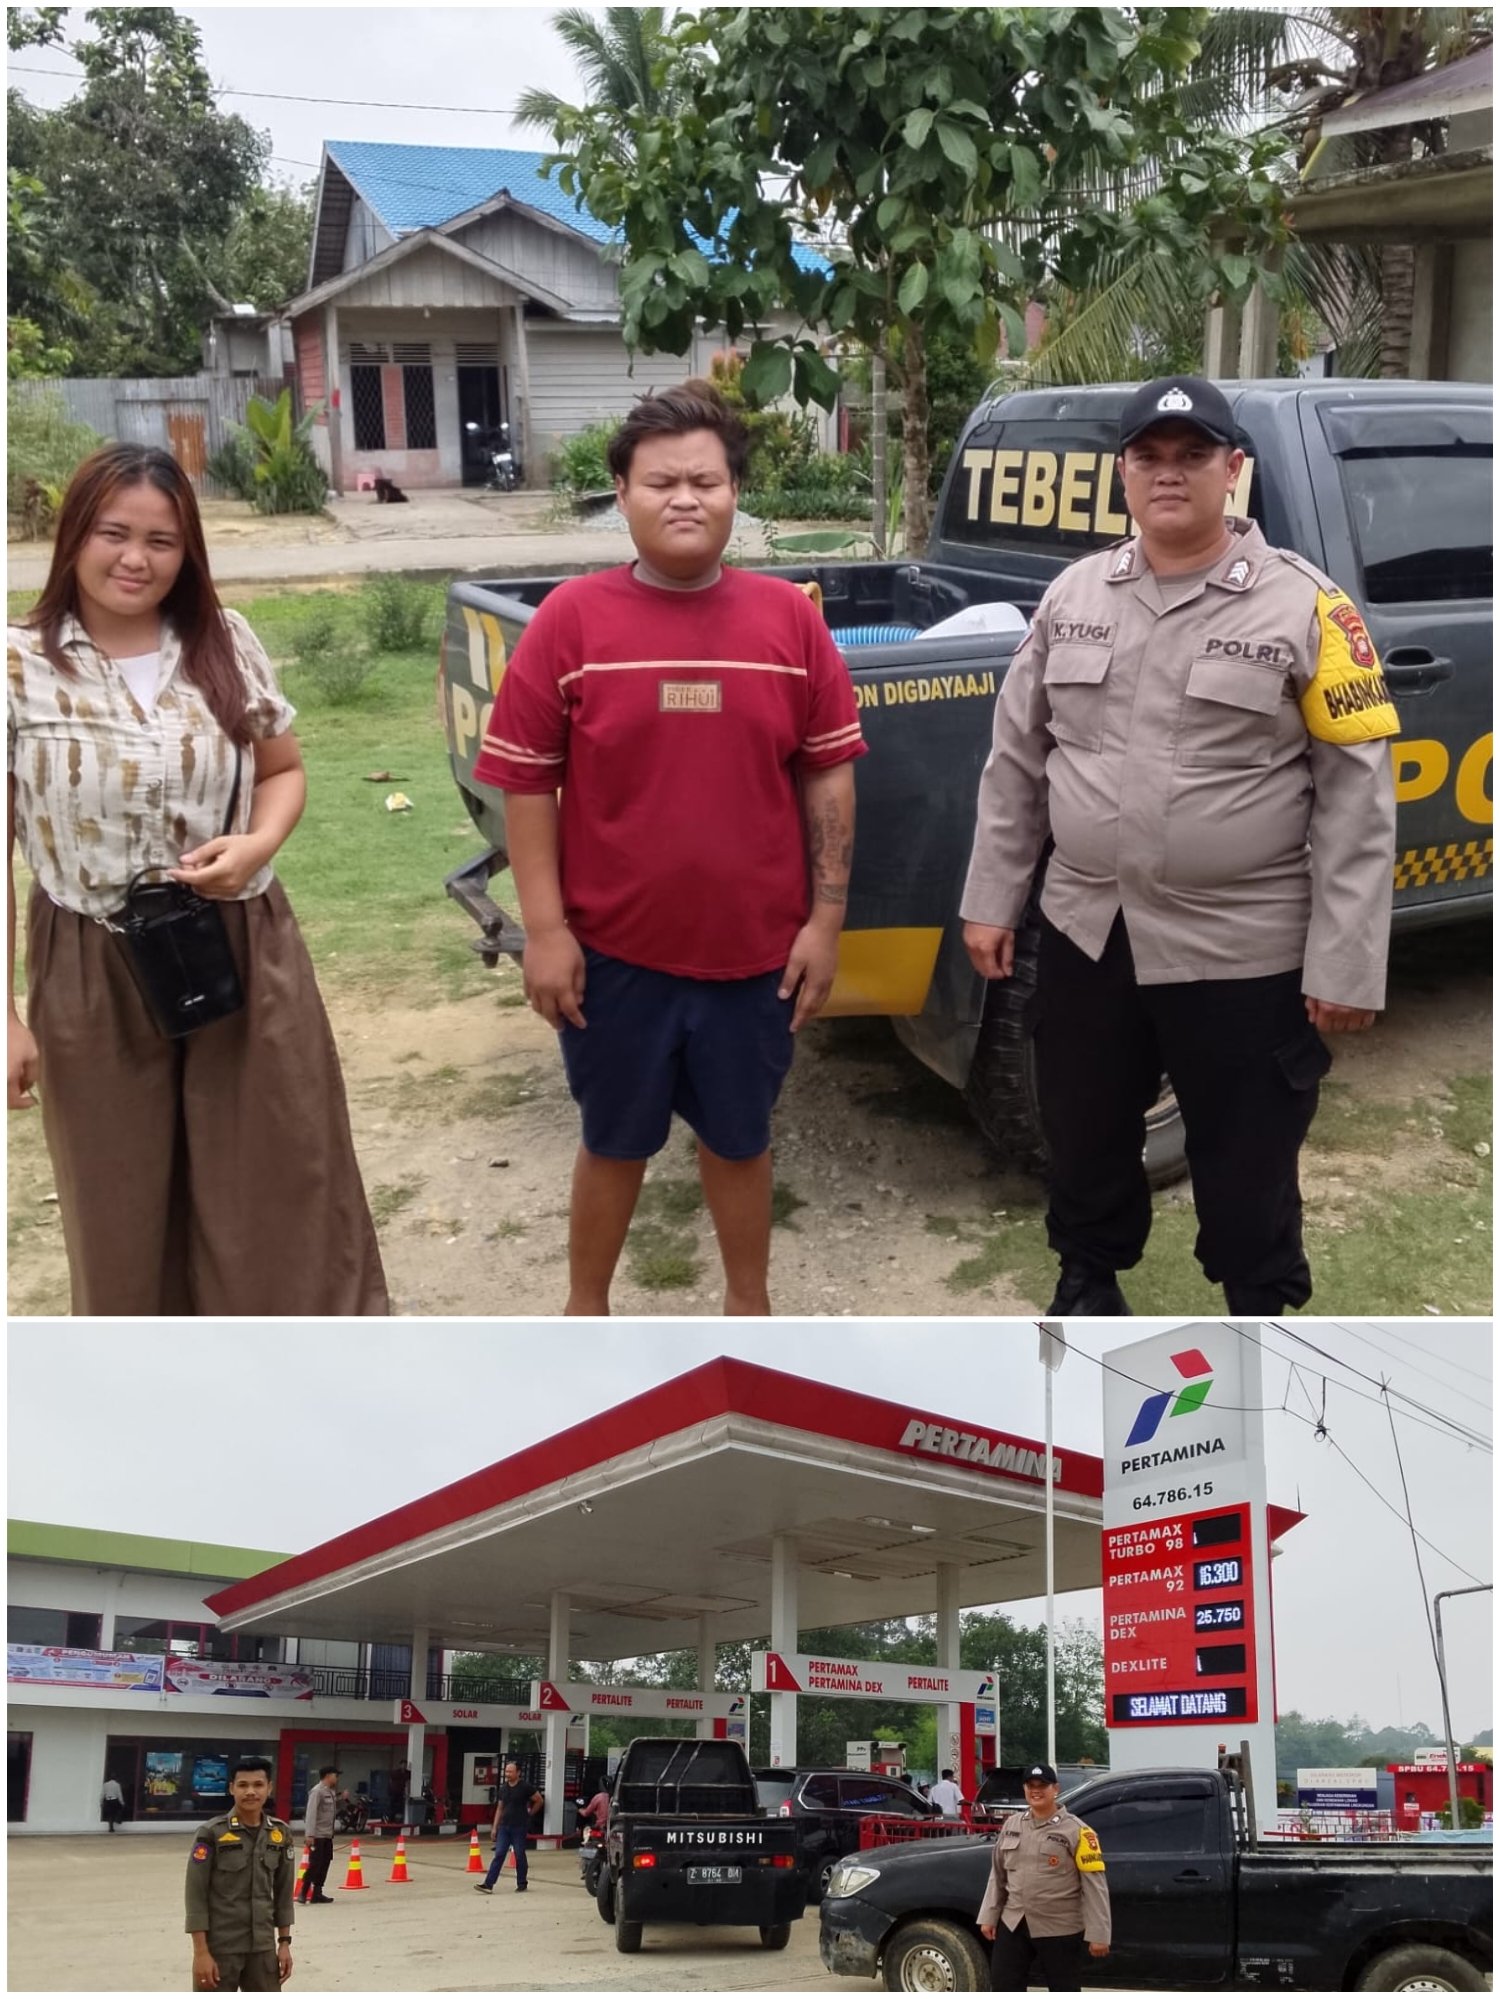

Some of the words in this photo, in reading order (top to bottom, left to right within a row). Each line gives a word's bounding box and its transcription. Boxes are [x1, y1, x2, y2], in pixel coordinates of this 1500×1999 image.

[963, 449, 1254, 535] TEBELN
[1054, 622, 1110, 641] K.YUGI
[1205, 638, 1280, 663] POLRI
[884, 672, 995, 706] DIGDAYAAJI
[667, 692, 715, 706] RIHUI
[1121, 1437, 1226, 1475] PERTAMINA
[1133, 1481, 1213, 1510] 64.786.15
[1109, 1523, 1183, 1547] PERTAMAX
[1109, 1543, 1155, 1559] TURBO
[1166, 1538, 1184, 1551] 98
[1109, 1565, 1184, 1587] PERTAMAX
[1166, 1580, 1185, 1592] 92
[1110, 1607, 1187, 1626] PERTAMINA
[1196, 1607, 1241, 1625] 25.750
[1110, 1627, 1137, 1640] DEX
[769, 1660, 777, 1683] 1
[809, 1661, 858, 1676] PERTAMAX
[1111, 1657, 1167, 1673] DEXLITE
[809, 1676, 862, 1691] PERTAMINA
[865, 1680, 882, 1693] DEX
[907, 1676, 949, 1691] PERTALITE
[542, 1687, 552, 1705] 2
[592, 1693, 632, 1706] PERTALITE
[666, 1698, 703, 1710] PERTALITE
[1130, 1695, 1178, 1717] SELAMAT
[1181, 1692, 1227, 1715] DATANG
[403, 1704, 412, 1719] 3
[452, 1709, 478, 1719] SOLAR
[518, 1711, 542, 1721] SOLAR
[1398, 1765, 1424, 1773] SPBU
[1426, 1765, 1475, 1773] 64.7.15
[667, 1832, 762, 1844] MITSUBISHI
